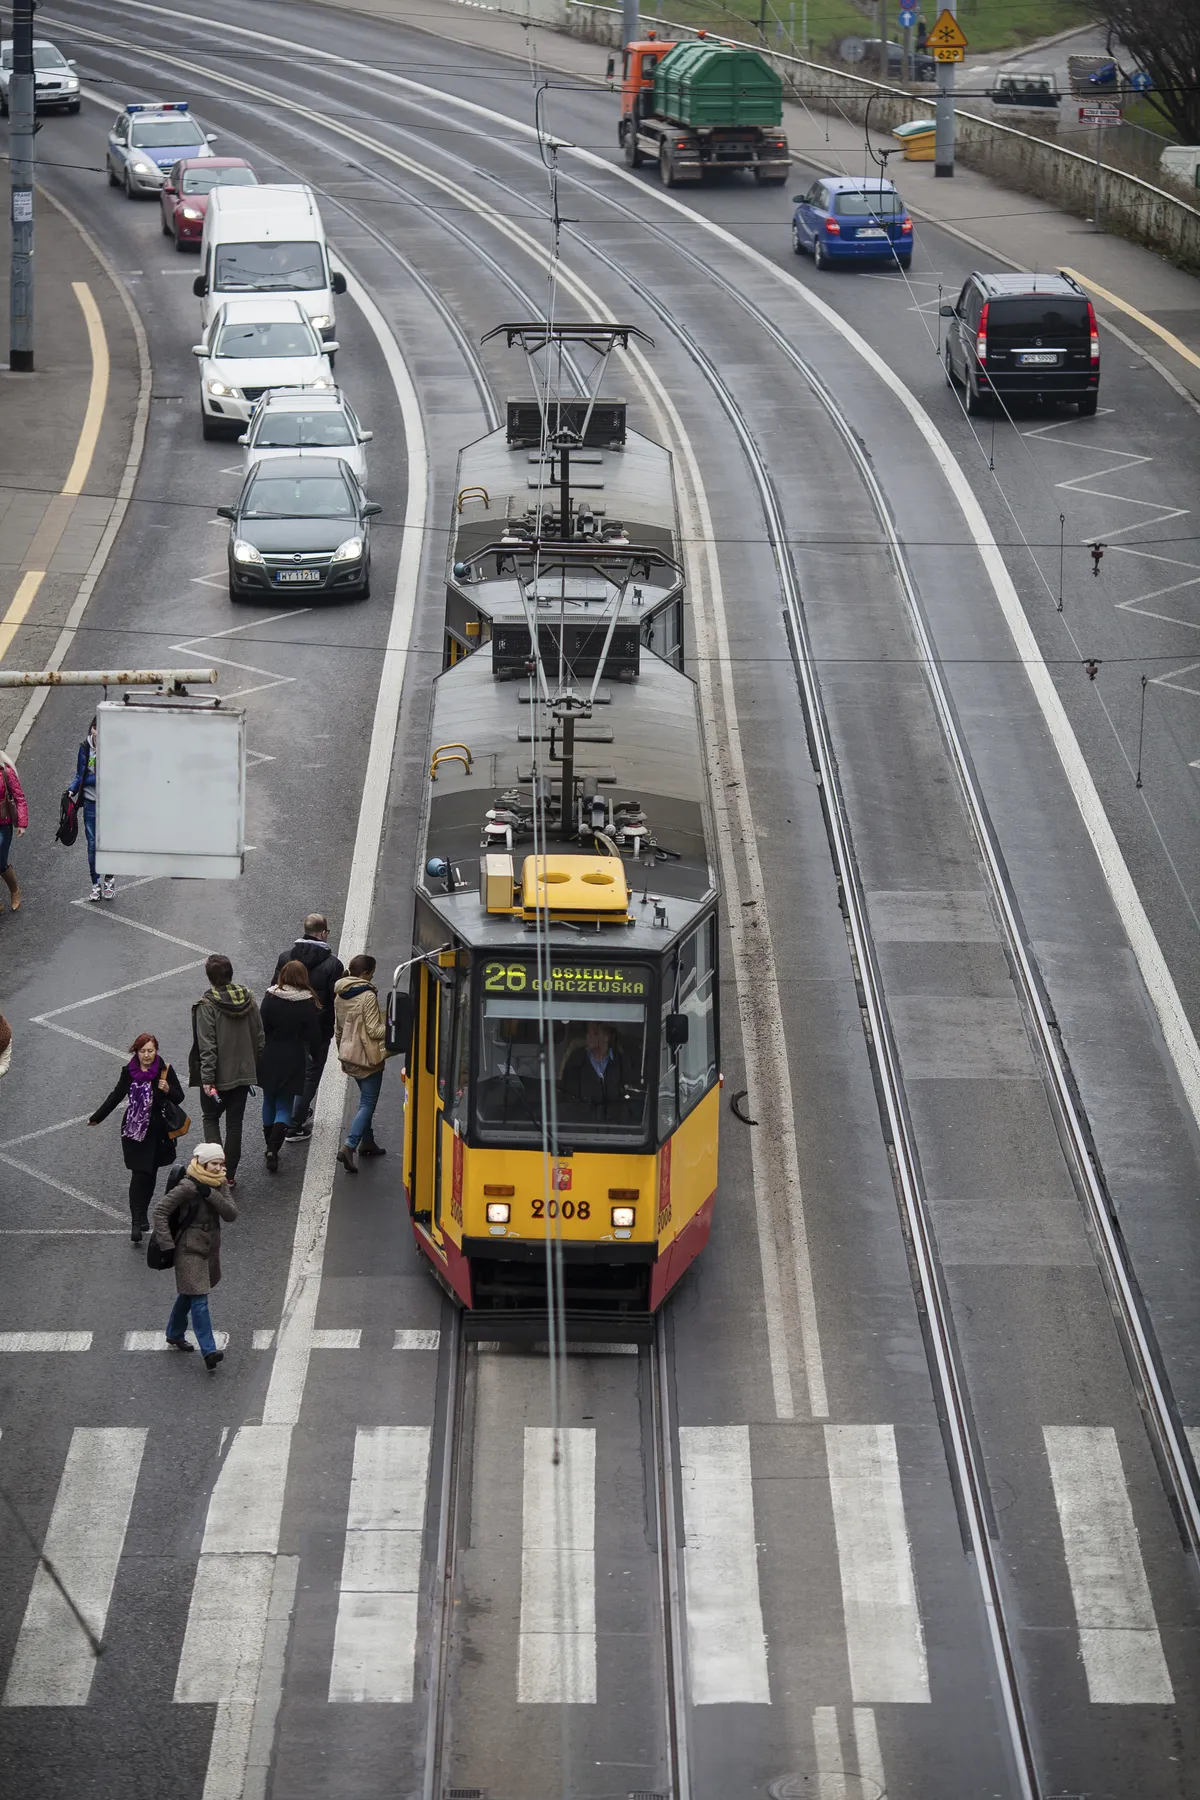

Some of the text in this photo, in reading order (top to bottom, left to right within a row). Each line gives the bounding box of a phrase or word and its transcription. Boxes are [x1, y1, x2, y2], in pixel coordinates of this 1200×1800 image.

[938, 50, 960, 60] 629
[485, 962, 527, 992] 26
[552, 967, 624, 981] OSIEDLE
[532, 977, 644, 994] GÓRCZEWSKA
[531, 1199, 591, 1221] 2008
